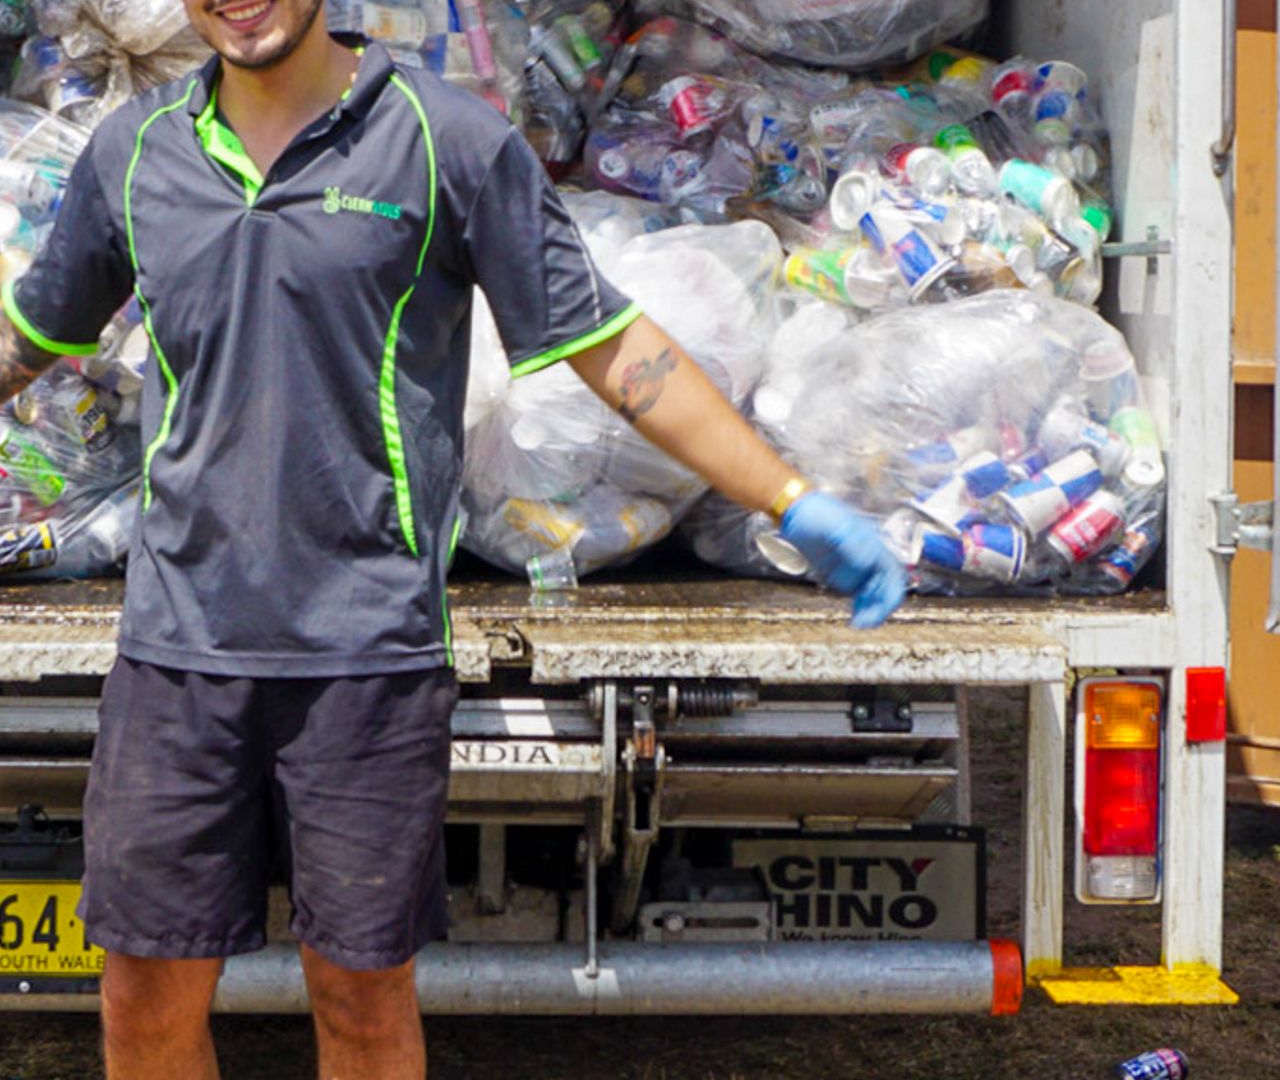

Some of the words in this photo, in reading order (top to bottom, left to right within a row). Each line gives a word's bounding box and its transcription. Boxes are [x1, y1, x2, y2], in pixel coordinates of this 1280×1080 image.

[451, 743, 553, 764] NDIA
[769, 855, 936, 891] CITY
[776, 893, 937, 929] HINO
[58, 955, 105, 968] WALE
